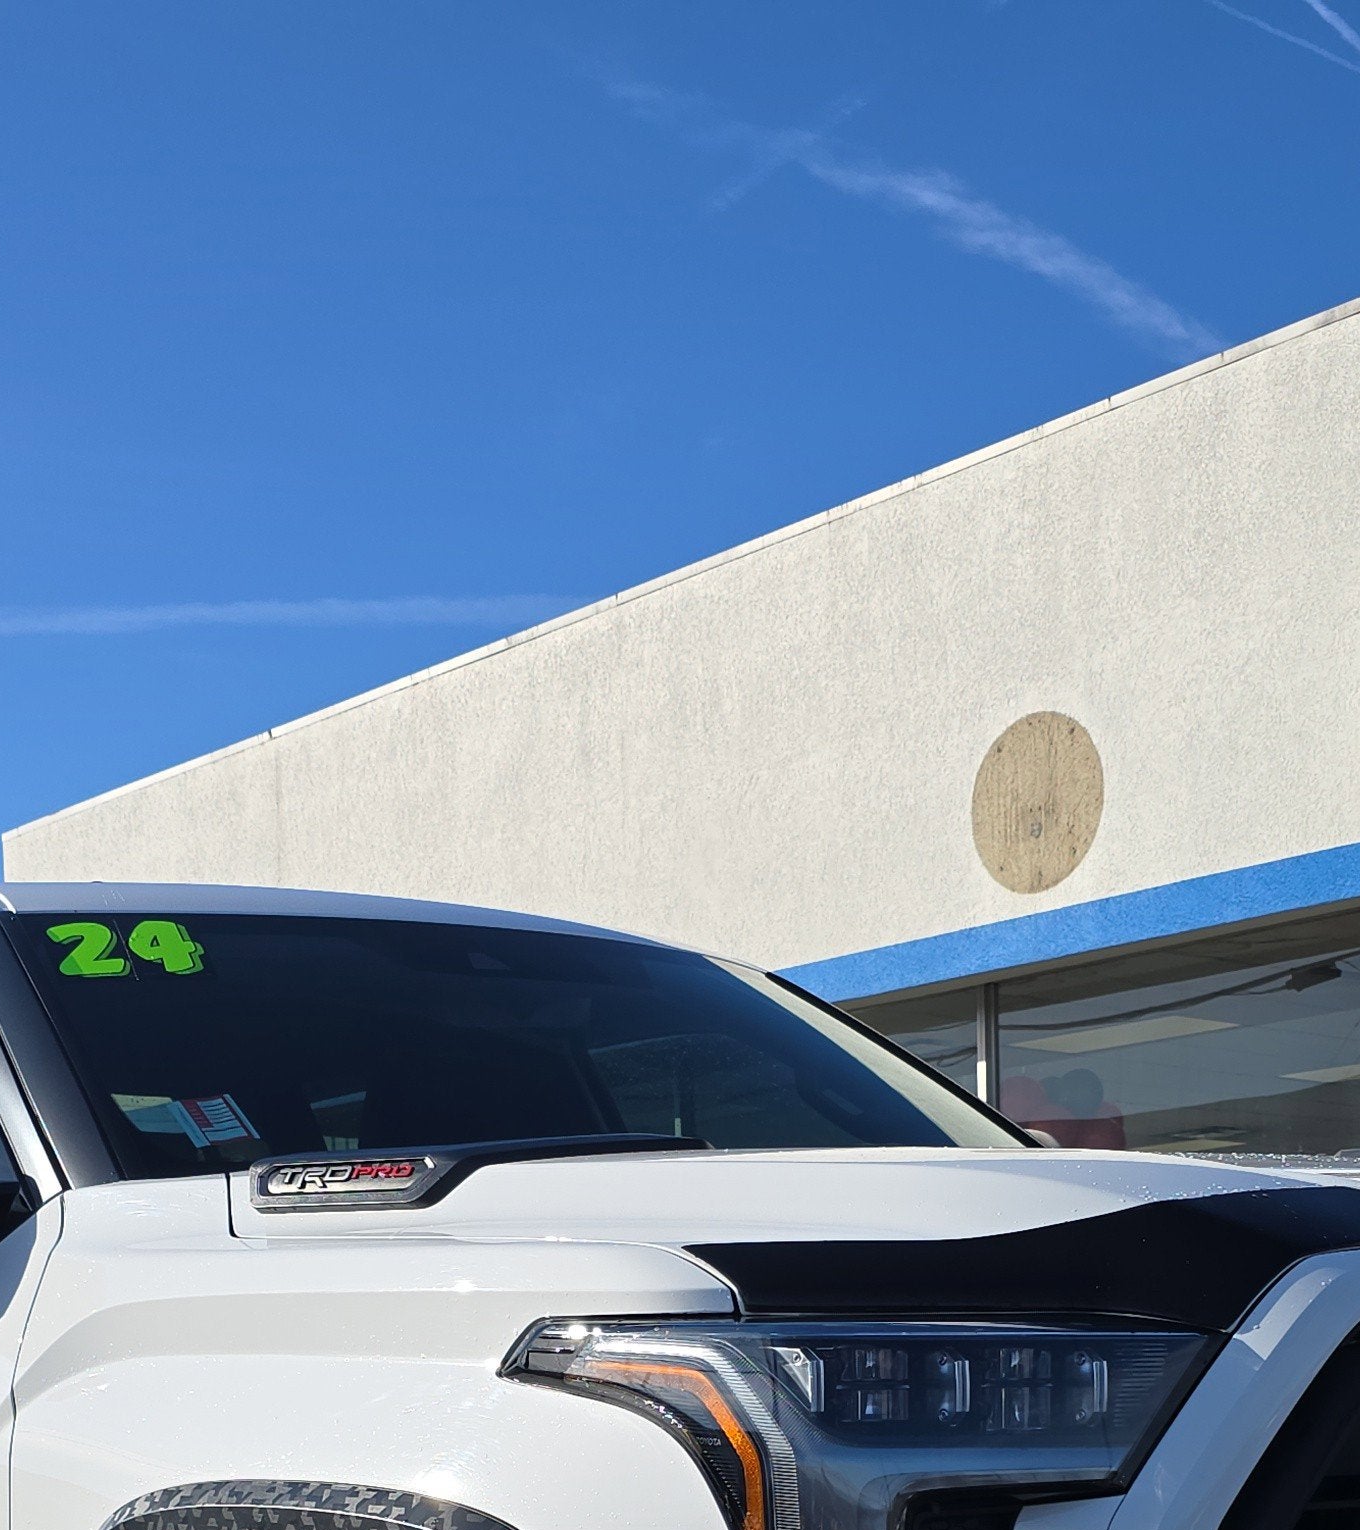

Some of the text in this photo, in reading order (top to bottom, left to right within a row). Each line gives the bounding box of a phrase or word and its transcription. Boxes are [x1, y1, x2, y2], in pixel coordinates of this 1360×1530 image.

[47, 920, 205, 976] 24
[280, 1162, 416, 1189] TRD PRO
